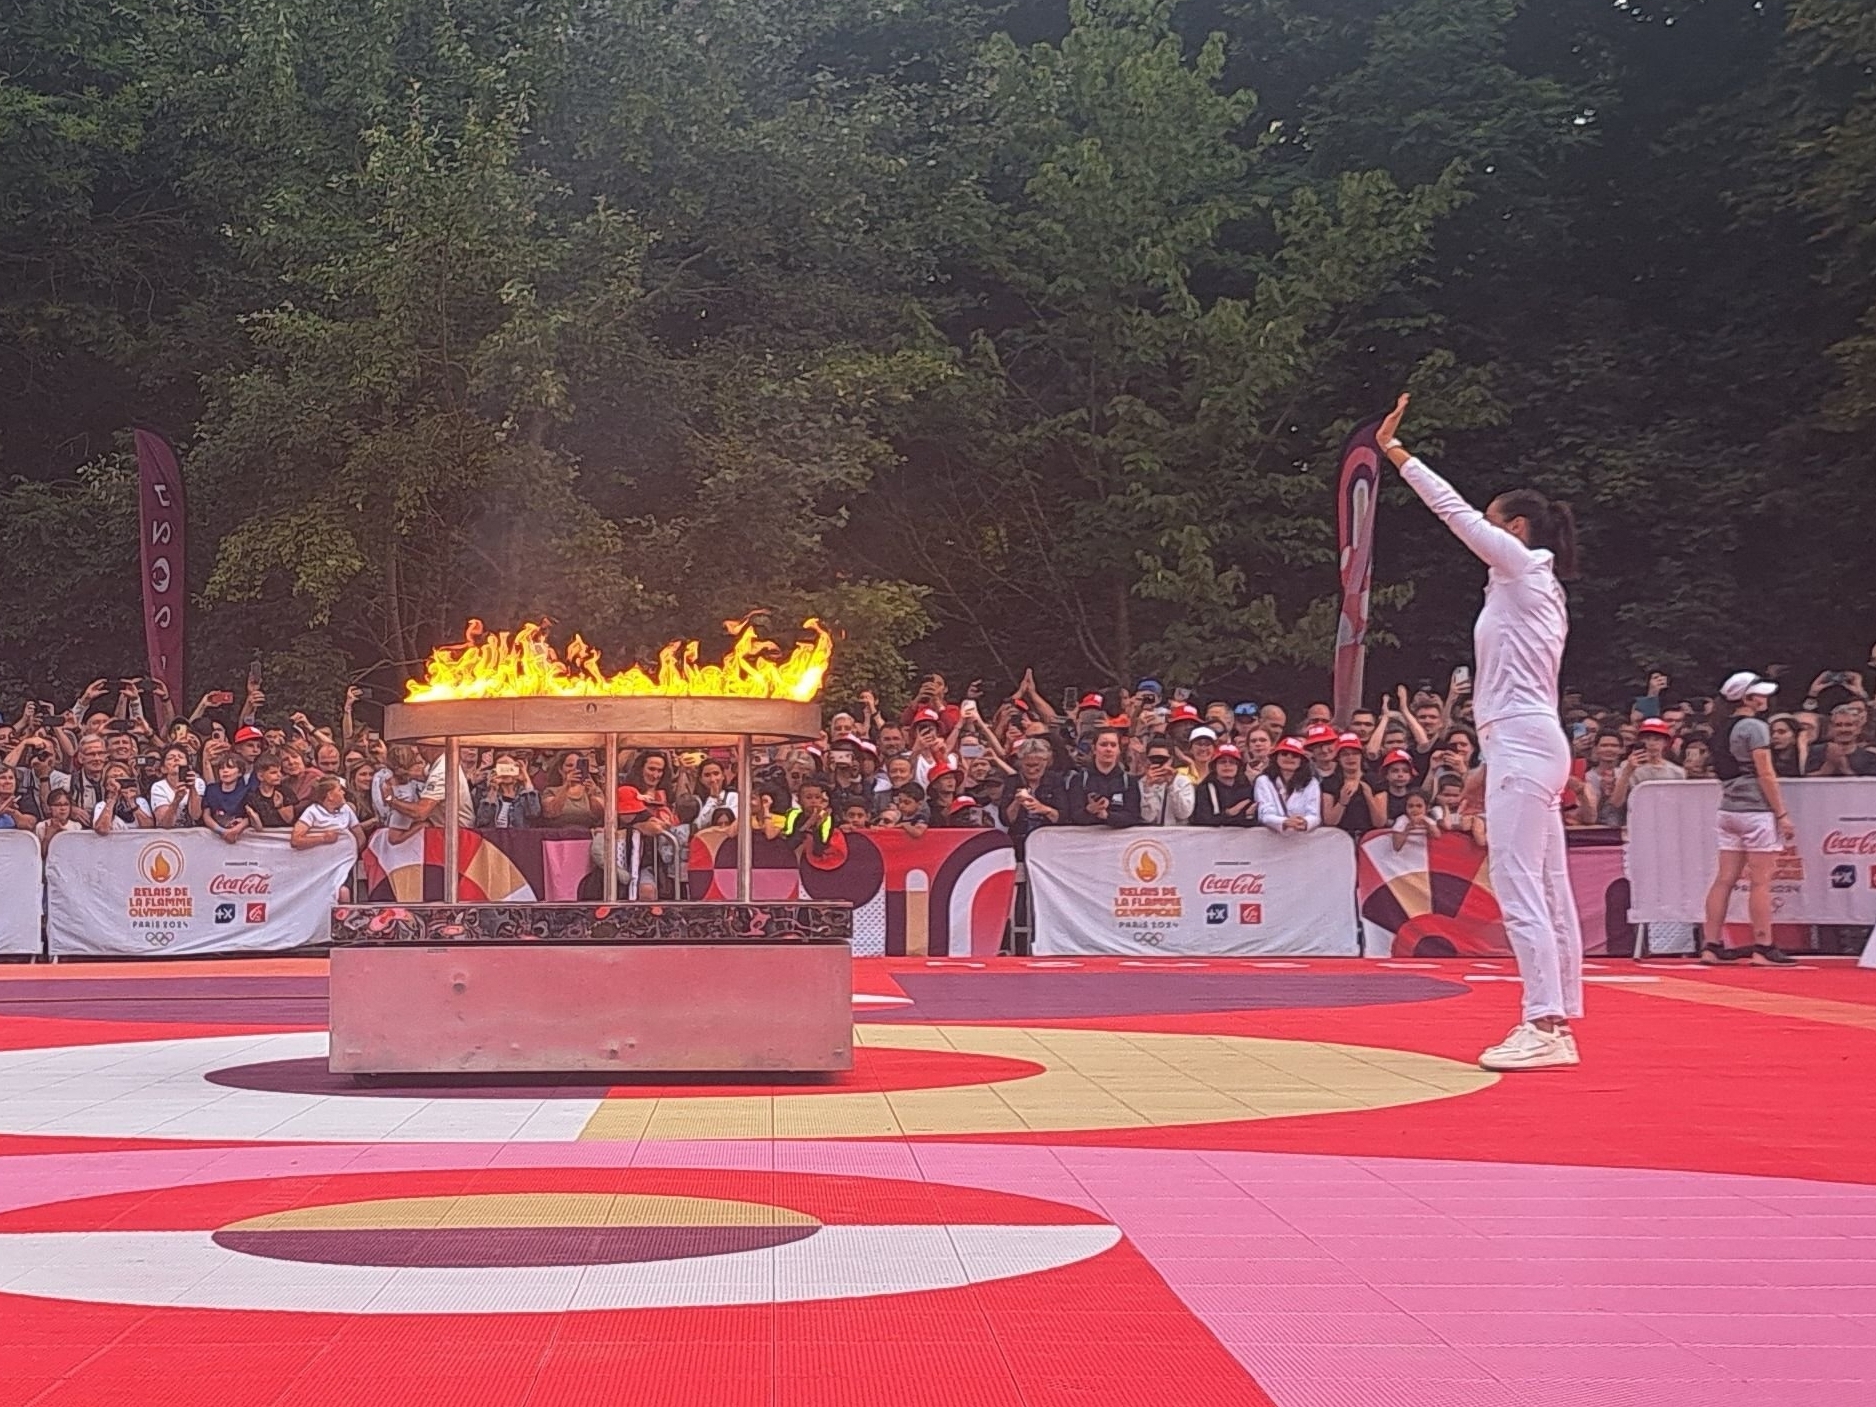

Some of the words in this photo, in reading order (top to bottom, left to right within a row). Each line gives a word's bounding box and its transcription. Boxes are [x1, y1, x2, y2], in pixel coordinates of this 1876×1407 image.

[133, 887, 172, 897] RELAIS
[174, 887, 188, 897] DE
[129, 898, 142, 907] LA
[145, 898, 193, 907] FLAMME
[129, 908, 193, 917] OLYMPIQUE
[133, 920, 160, 929] PARIS
[163, 920, 188, 929] 2024
[1118, 921, 1148, 929] PARIS
